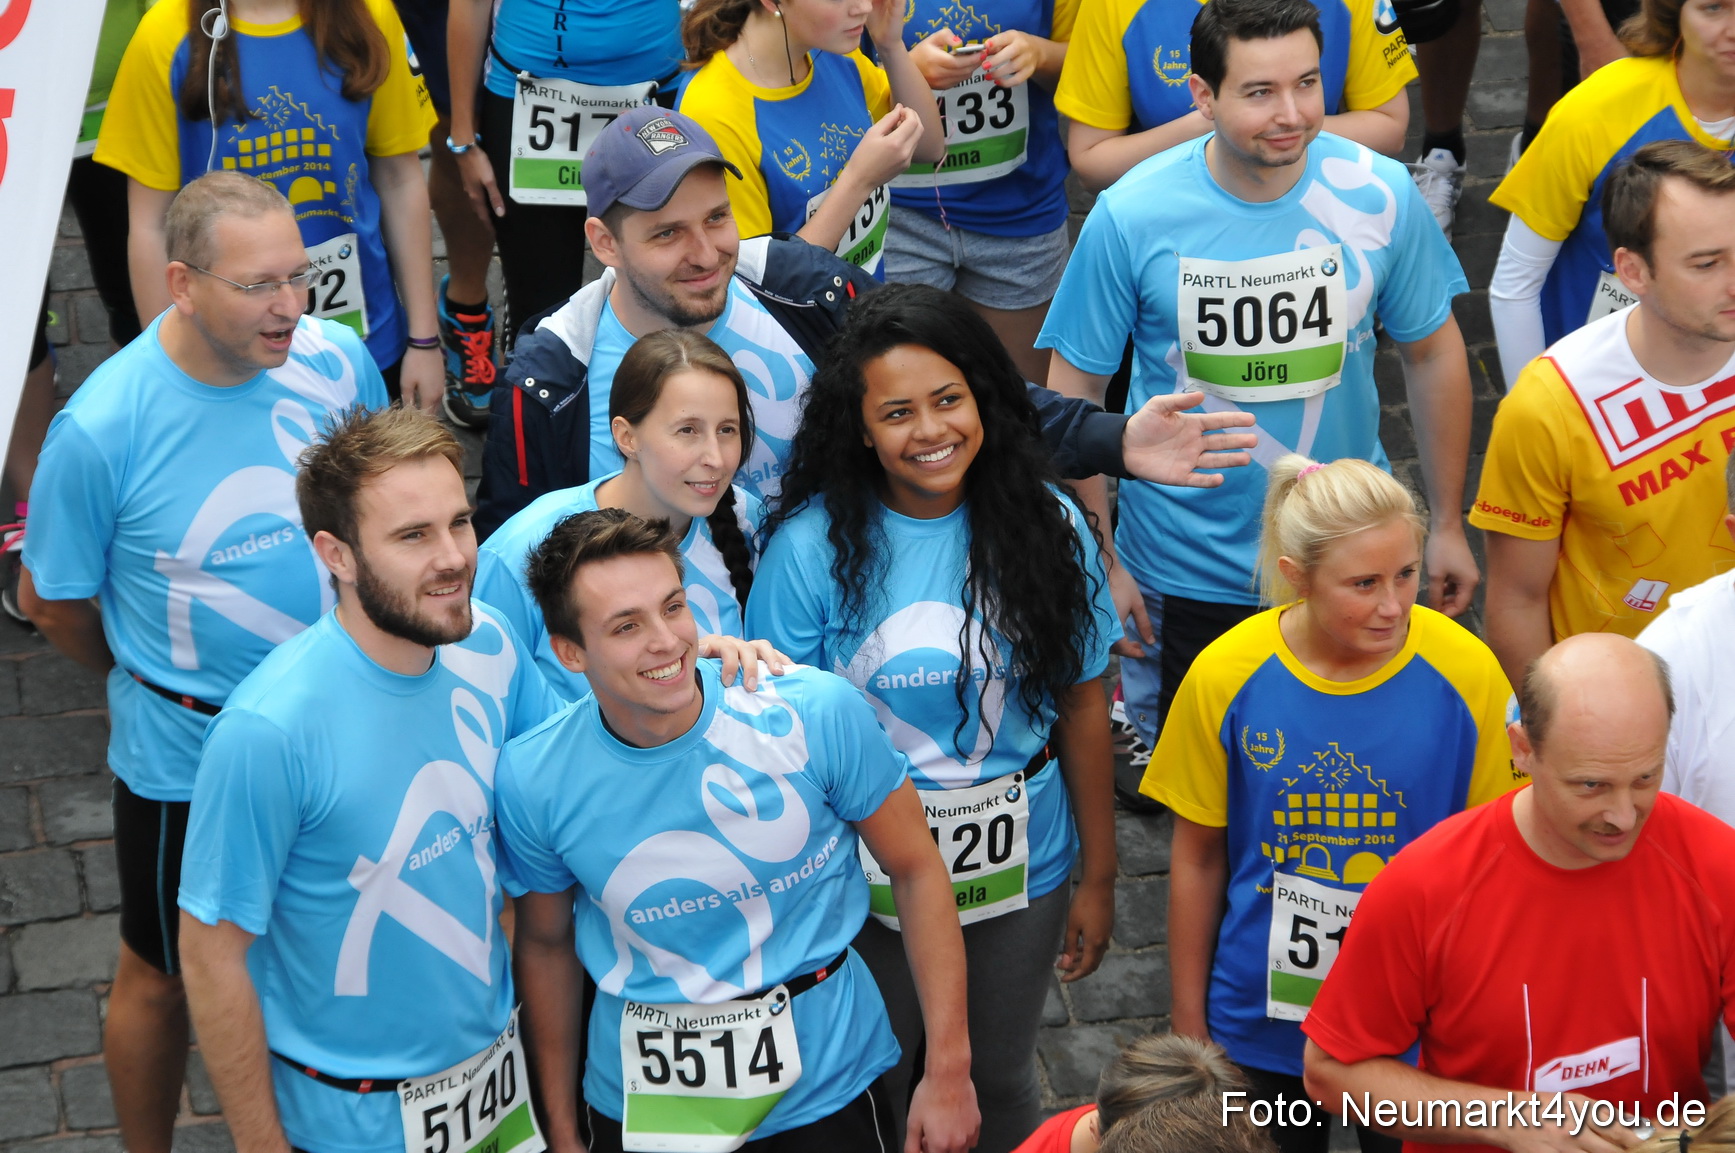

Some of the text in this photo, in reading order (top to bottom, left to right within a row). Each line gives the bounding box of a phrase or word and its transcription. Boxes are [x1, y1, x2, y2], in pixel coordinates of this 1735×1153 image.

[1169, 49, 1180, 58] 15
[1382, 34, 1407, 61] PAR
[1162, 61, 1188, 71] Jahre
[570, 93, 638, 109] Neumarkt
[642, 125, 657, 139] NEW
[650, 132, 684, 143] RANGERS
[783, 145, 793, 156] 15
[784, 153, 804, 170] Jahre
[303, 162, 331, 171] 2014
[1182, 264, 1316, 290] PARTL Neumarkt
[1197, 285, 1333, 348] 5064
[1241, 361, 1289, 384] Jörg
[1617, 439, 1712, 507] MAX
[210, 524, 294, 566] anders
[1250, 743, 1275, 755] Jahre
[1256, 732, 1268, 742] 15
[925, 795, 1000, 818] Neumarkt
[408, 826, 461, 871] anders
[1363, 833, 1396, 845] 2014
[629, 835, 840, 924] anders als andere
[1277, 887, 1331, 915] PARTL
[625, 1002, 762, 1031] PARTL Neumarkt
[636, 1026, 784, 1089] 5514
[1561, 1056, 1610, 1082] DEHN
[403, 1034, 506, 1106] PARTL Neumarkt
[421, 1050, 517, 1153] 5140
